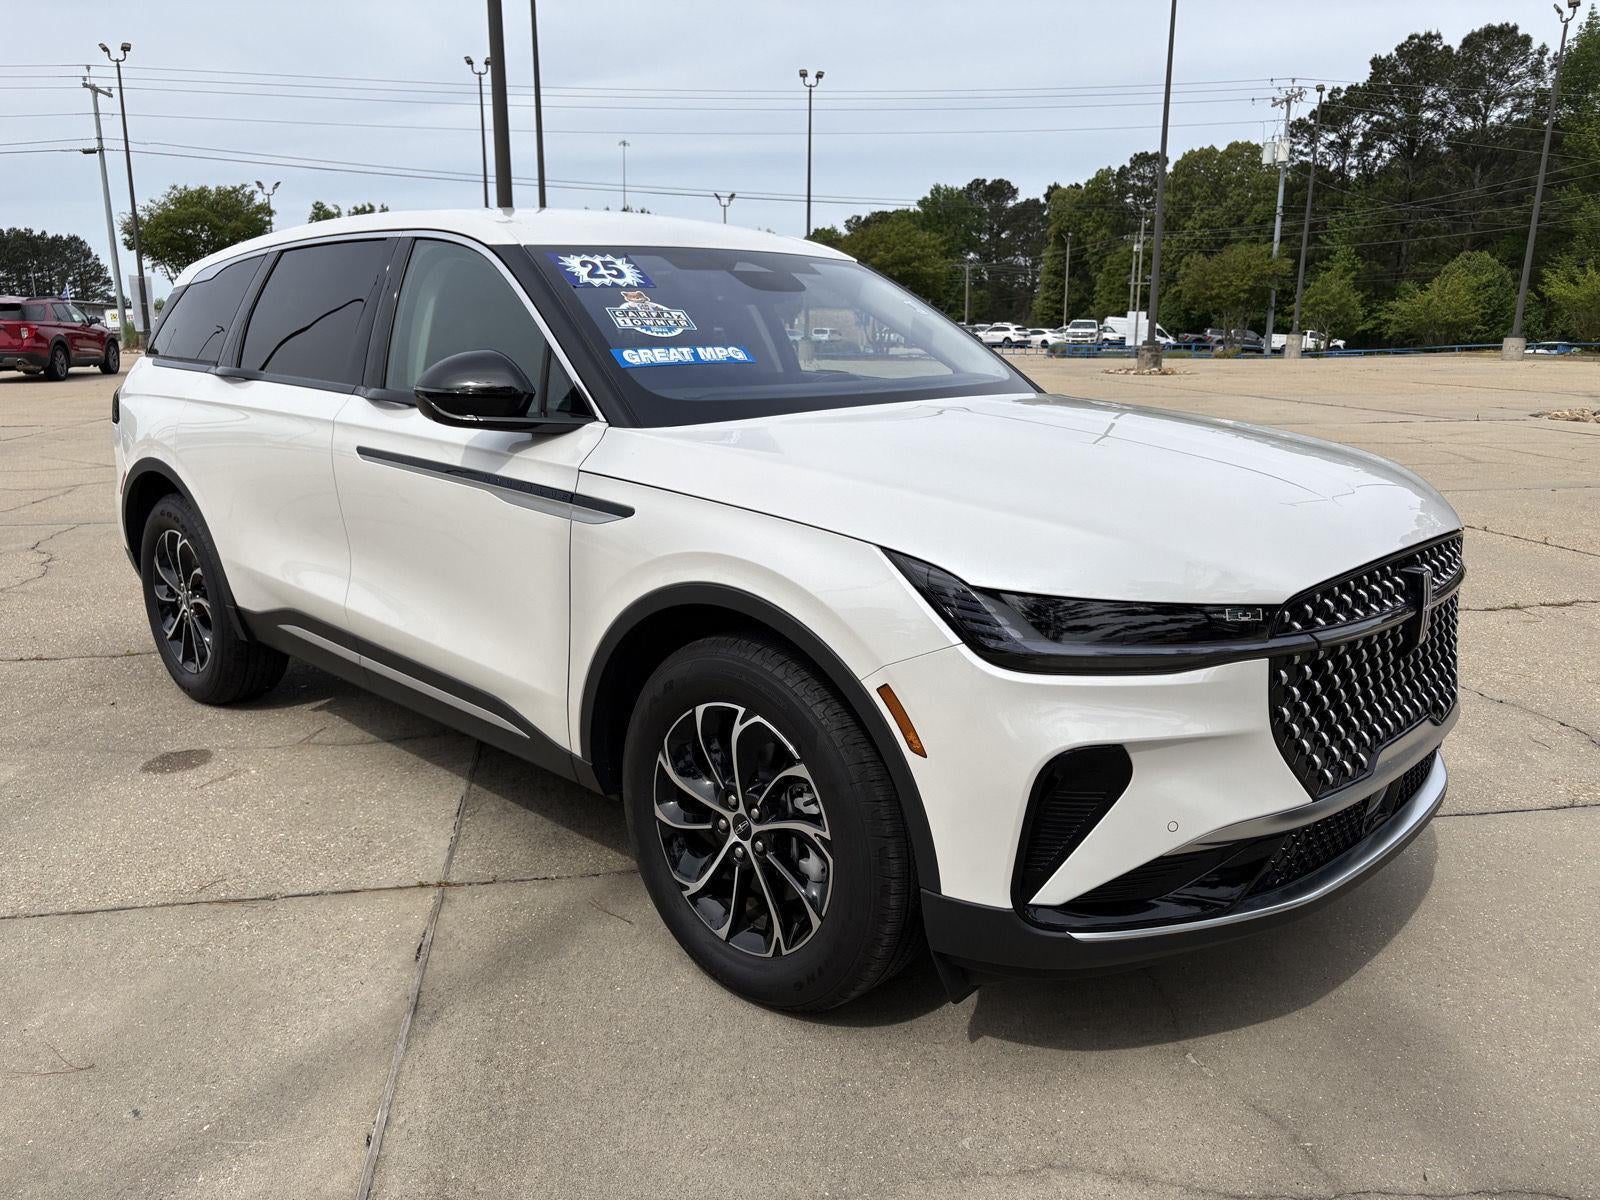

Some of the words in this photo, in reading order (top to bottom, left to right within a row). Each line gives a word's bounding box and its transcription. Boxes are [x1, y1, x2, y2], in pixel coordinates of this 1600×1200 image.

[579, 260, 626, 279] 25
[614, 310, 684, 319] CARFAX
[632, 319, 688, 327] OWNER
[622, 347, 694, 364] GREAT
[696, 346, 748, 361] MPG
